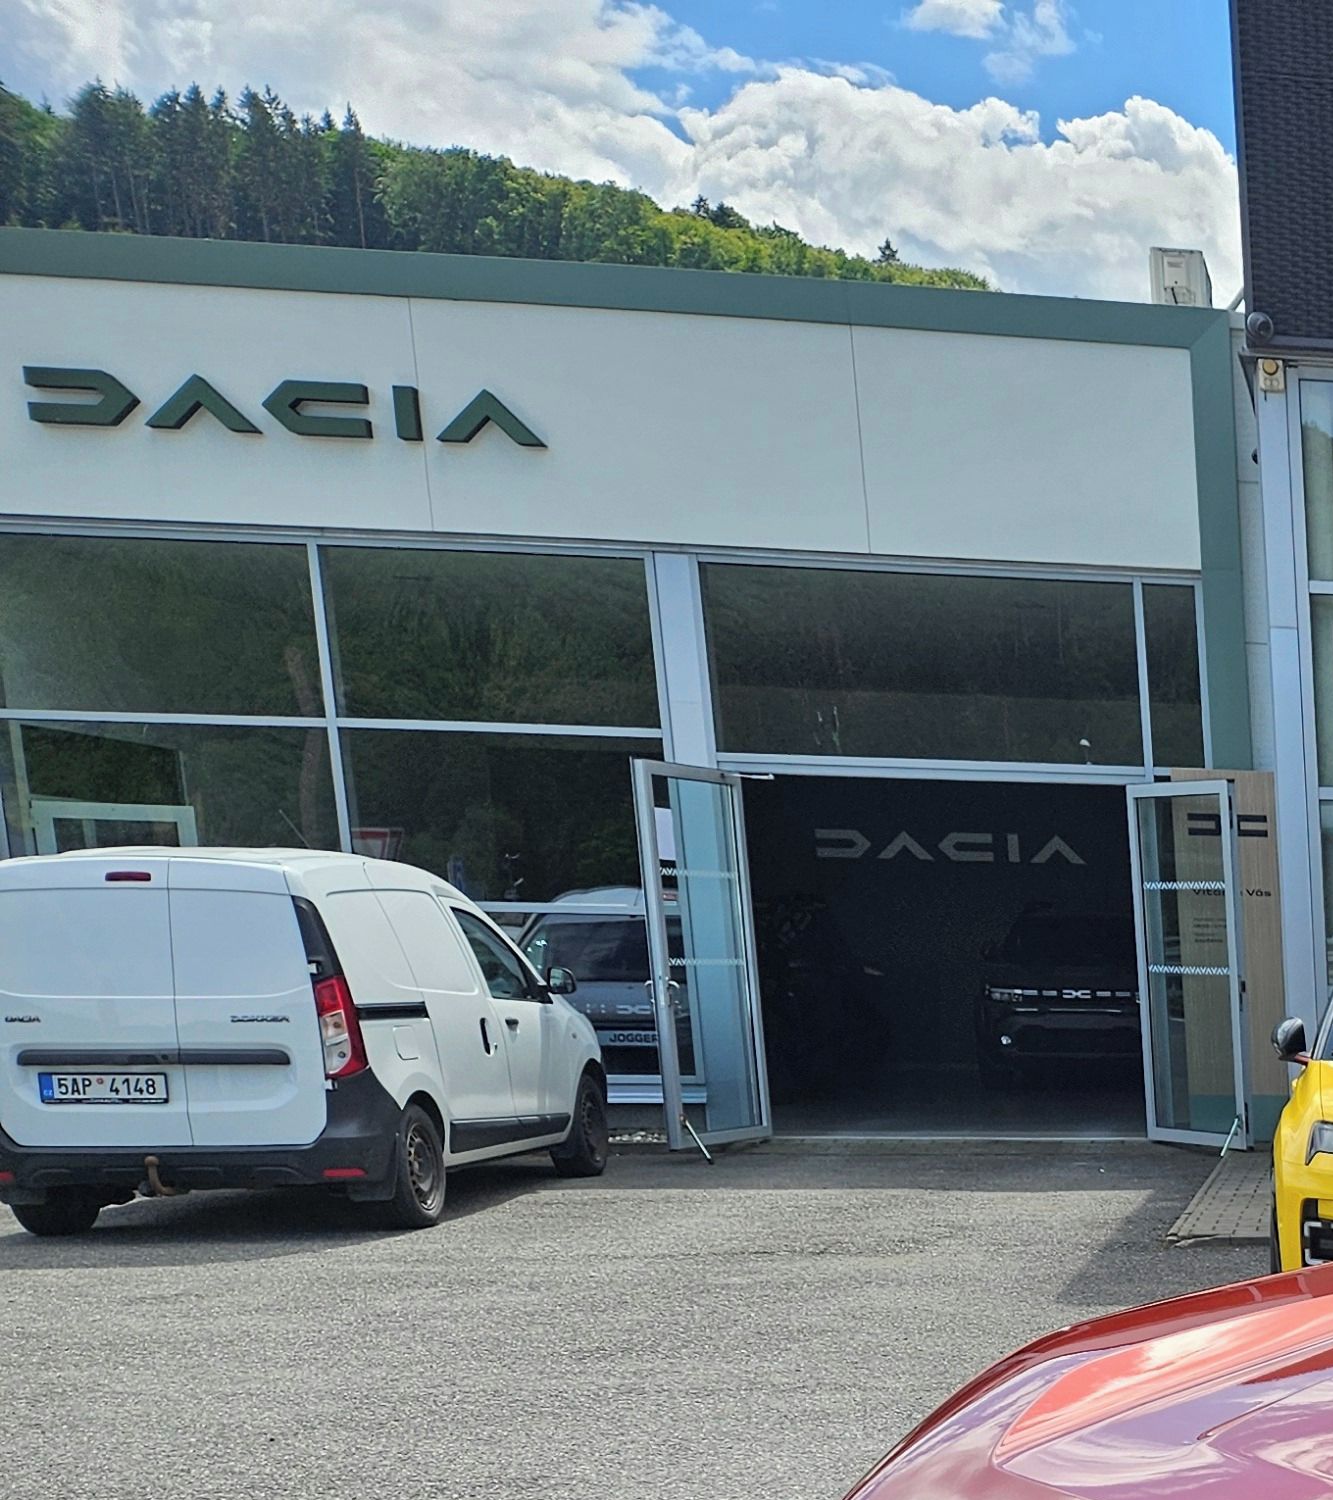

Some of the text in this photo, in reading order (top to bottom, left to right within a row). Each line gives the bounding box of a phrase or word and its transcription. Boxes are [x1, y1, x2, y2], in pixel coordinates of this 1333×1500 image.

[22, 365, 549, 449] DACIA
[815, 828, 1087, 865] DACIA
[57, 1077, 92, 1096] 5AP
[109, 1077, 157, 1096] 4148
